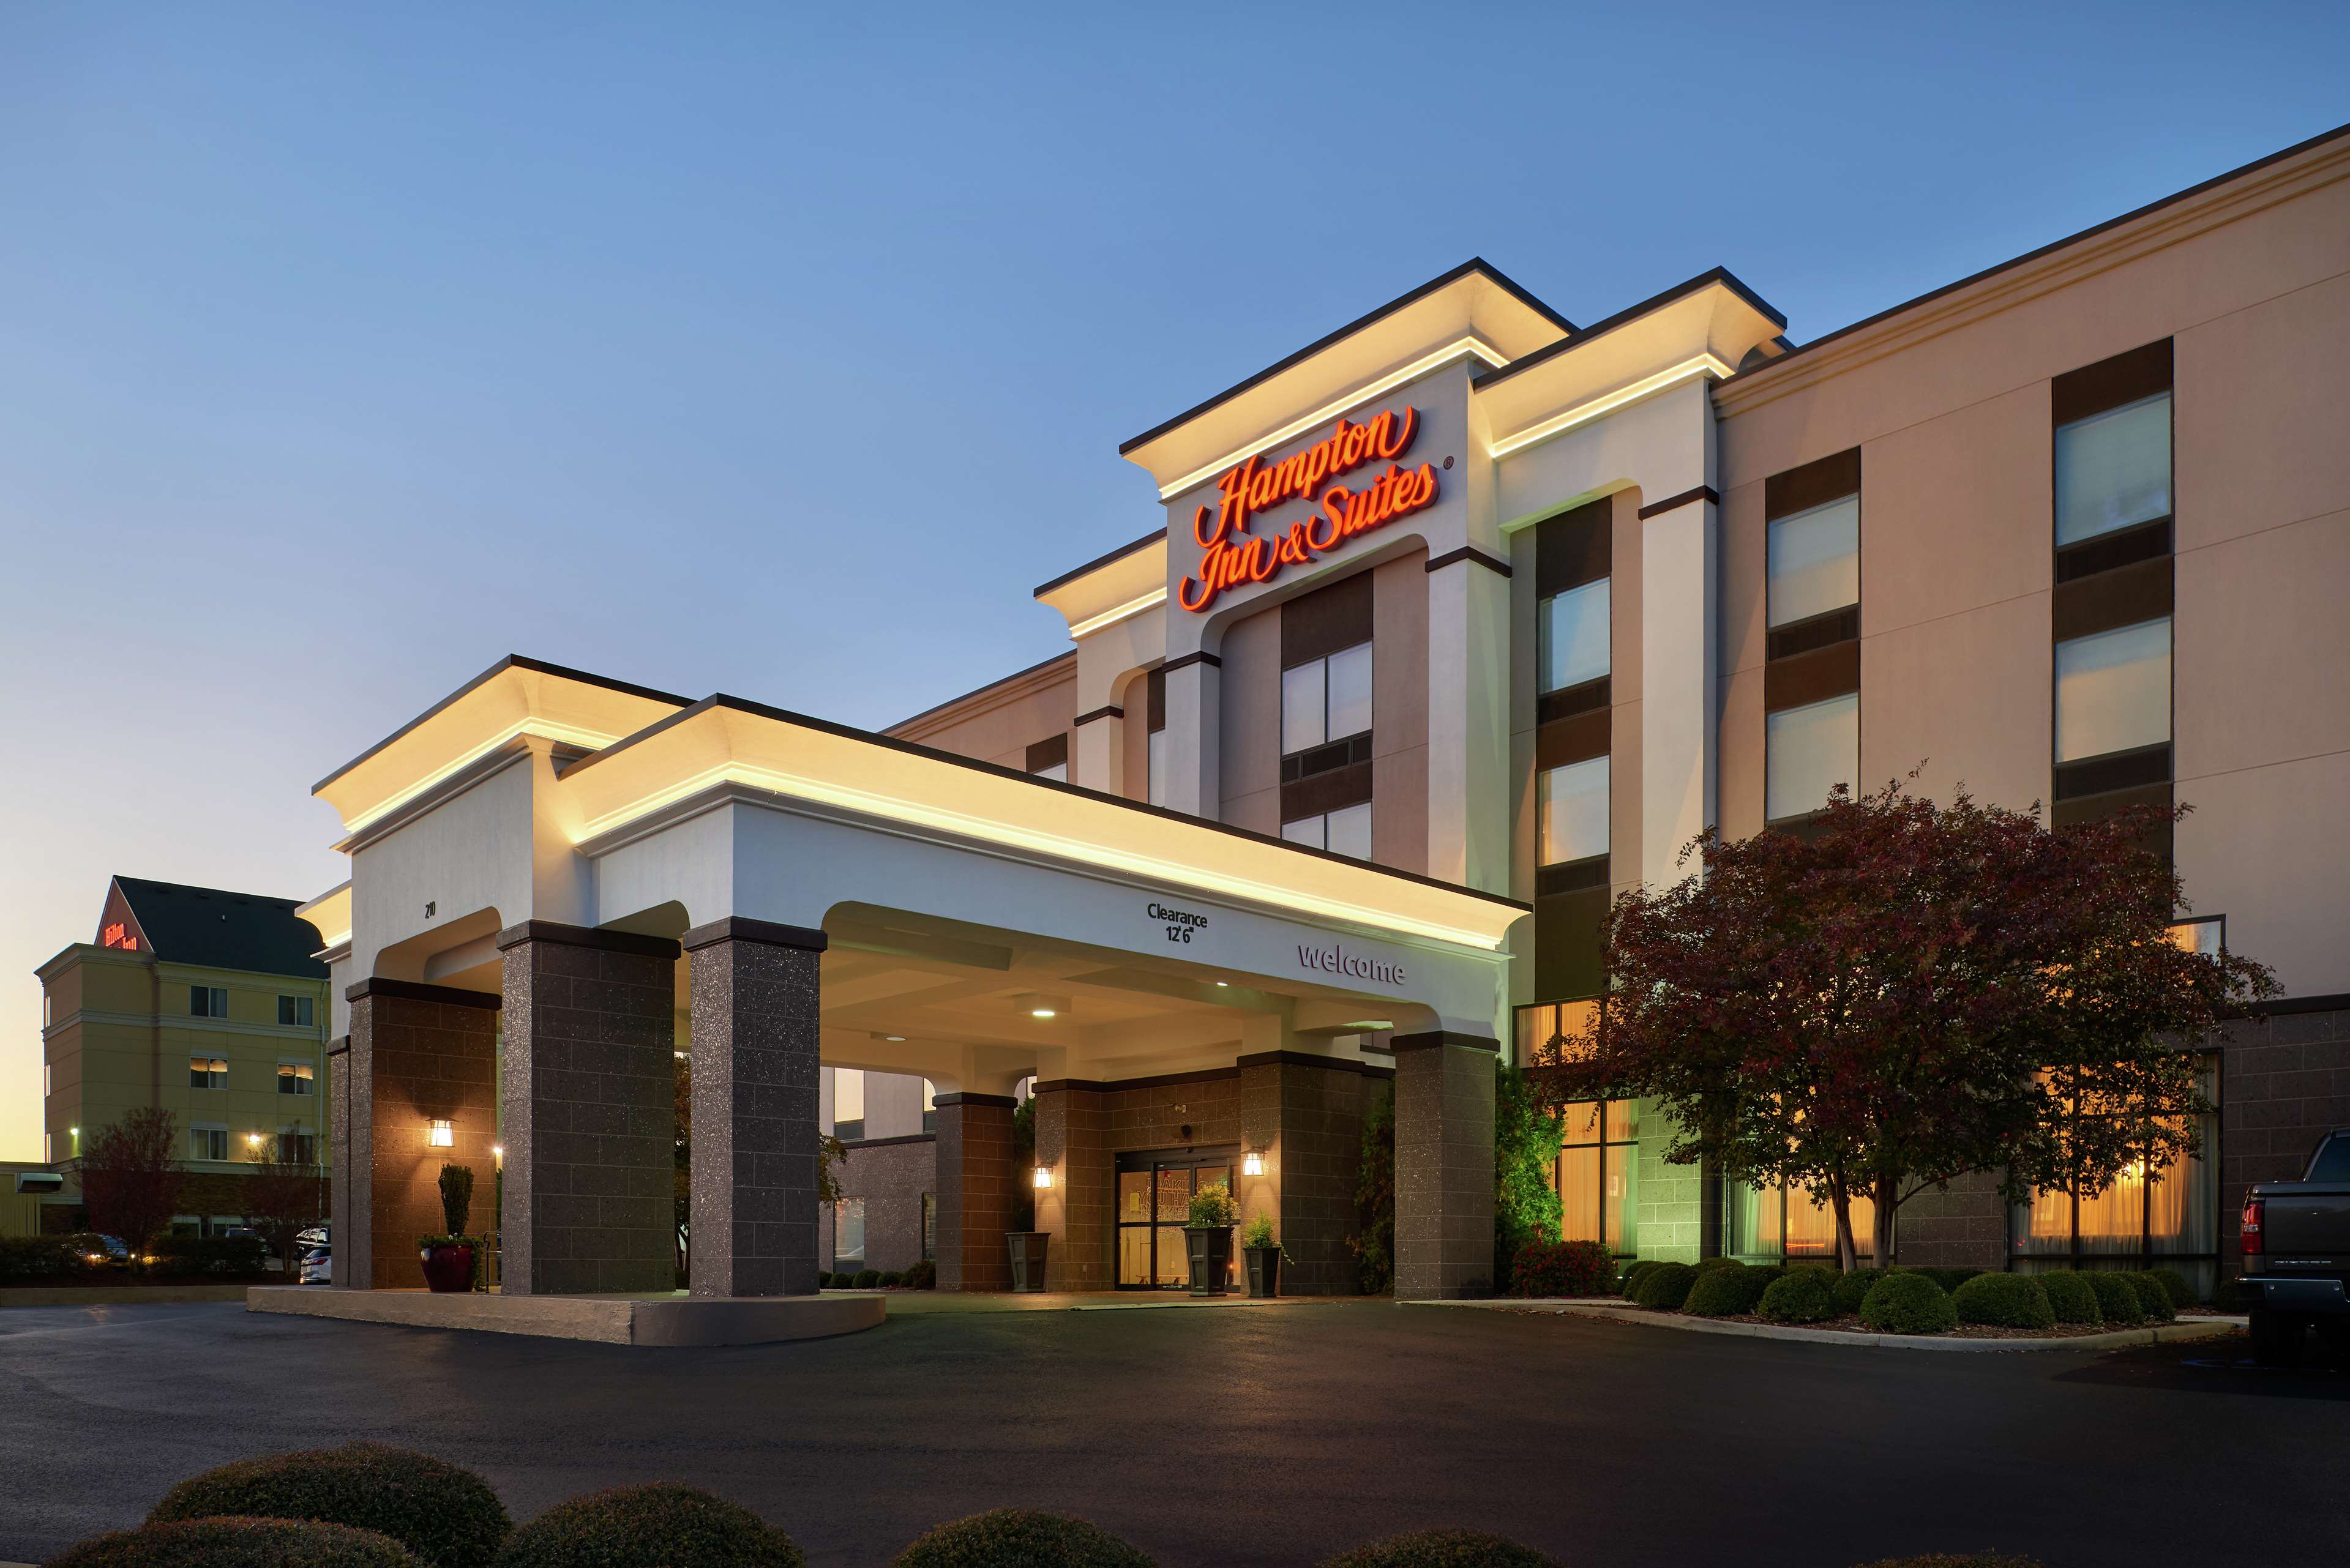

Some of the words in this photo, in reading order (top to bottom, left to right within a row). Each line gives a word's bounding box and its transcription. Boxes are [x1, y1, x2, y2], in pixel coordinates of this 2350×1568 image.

[1194, 405, 1418, 548] Hampton
[1178, 534, 1282, 612] Inn
[1281, 521, 1311, 563] &
[1306, 463, 1437, 550] Suites
[425, 901, 436, 919] 210
[1147, 903, 1208, 928] Clearance
[105, 923, 125, 947] Hilton
[122, 936, 137, 950] Inn
[1298, 945, 1406, 985] welcome
